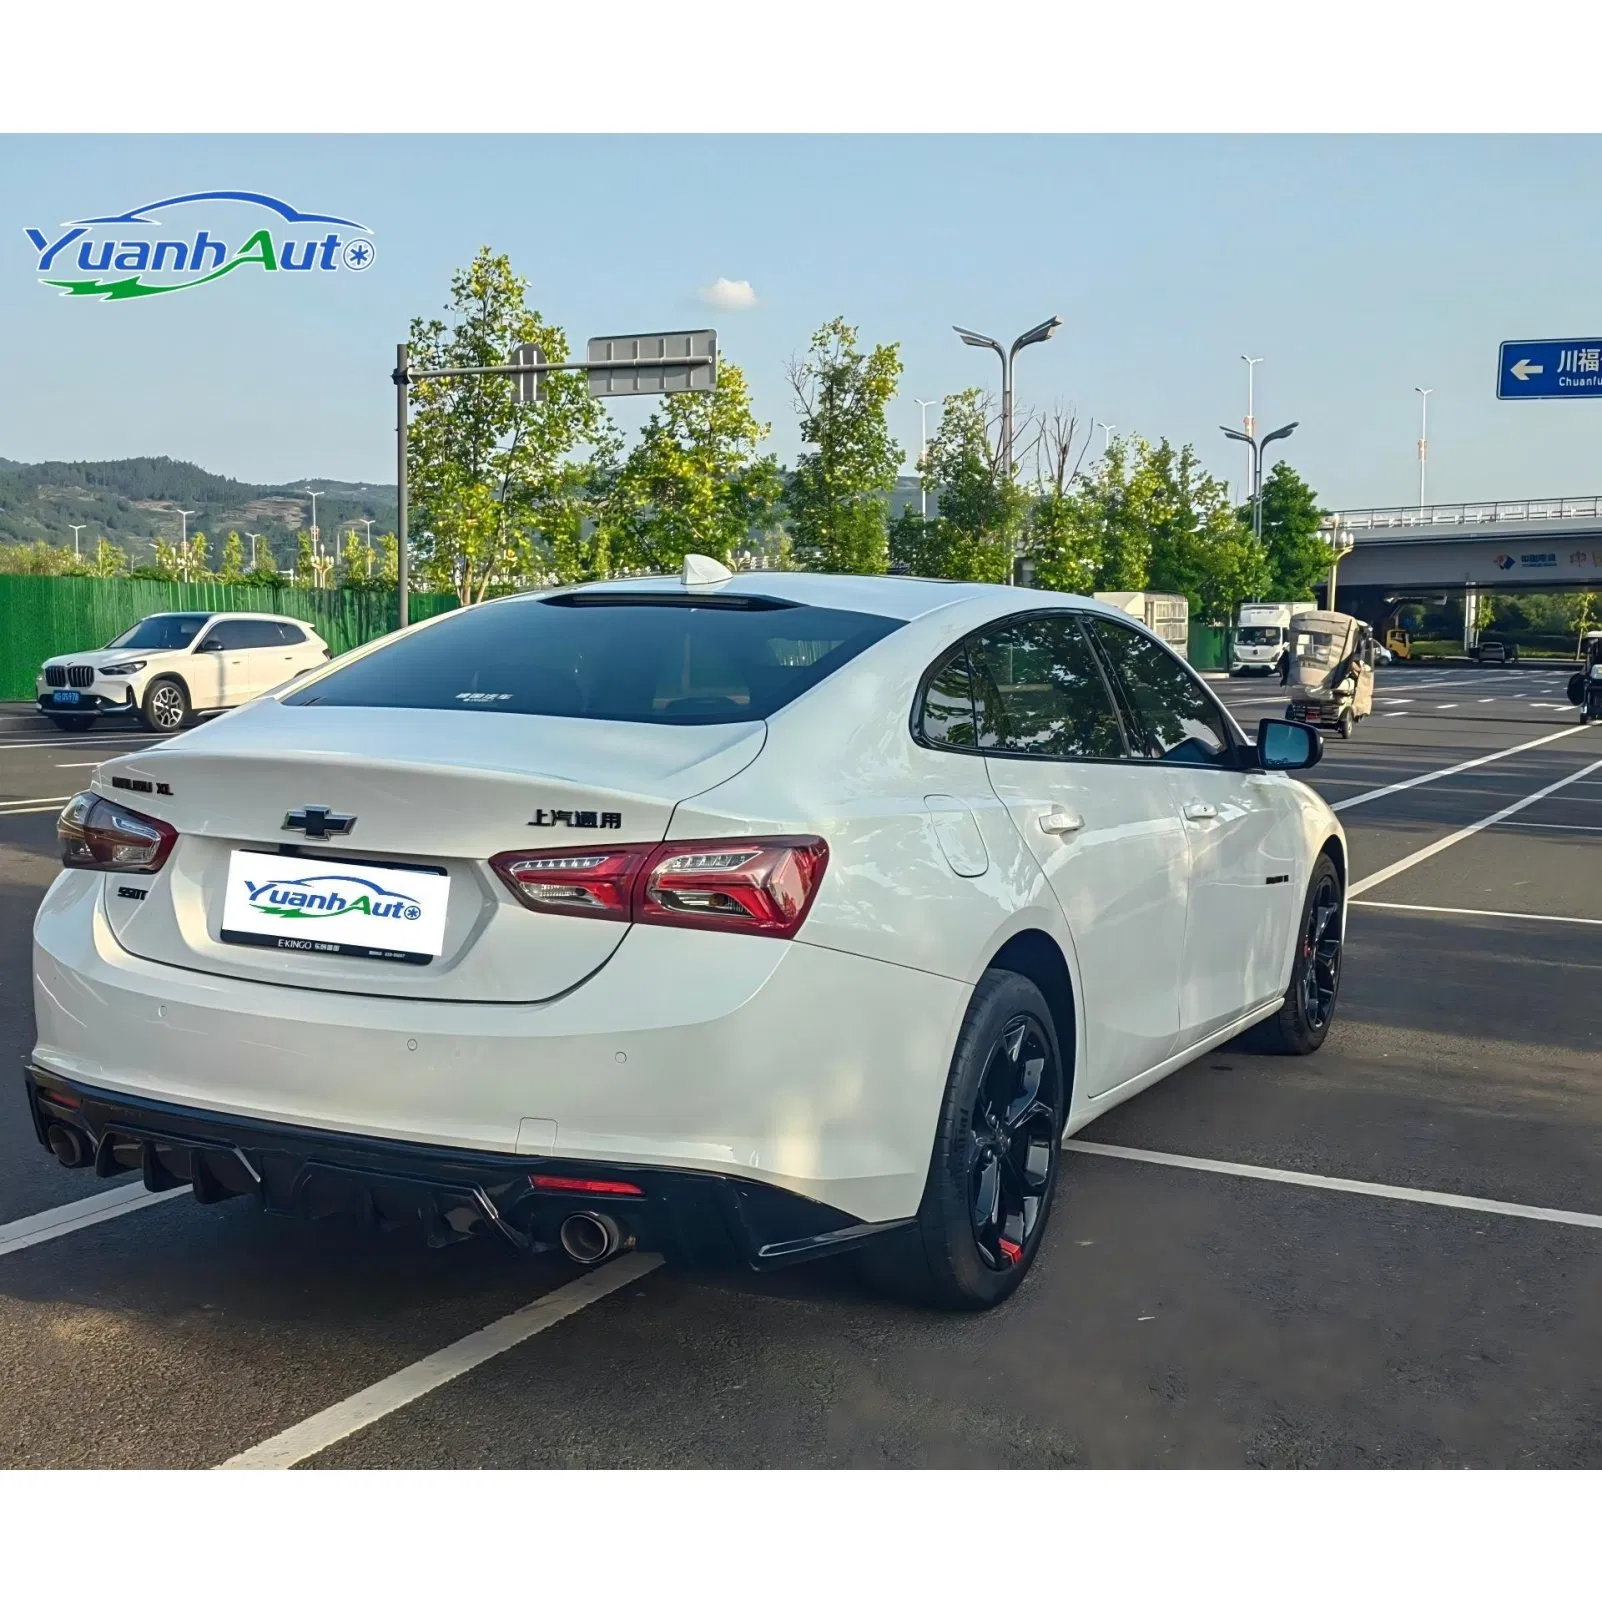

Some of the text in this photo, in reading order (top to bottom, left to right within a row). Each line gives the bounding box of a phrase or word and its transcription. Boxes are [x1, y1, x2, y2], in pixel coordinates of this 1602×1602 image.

[1557, 348, 1602, 373] 川福
[526, 808, 622, 829] 上汽通用
